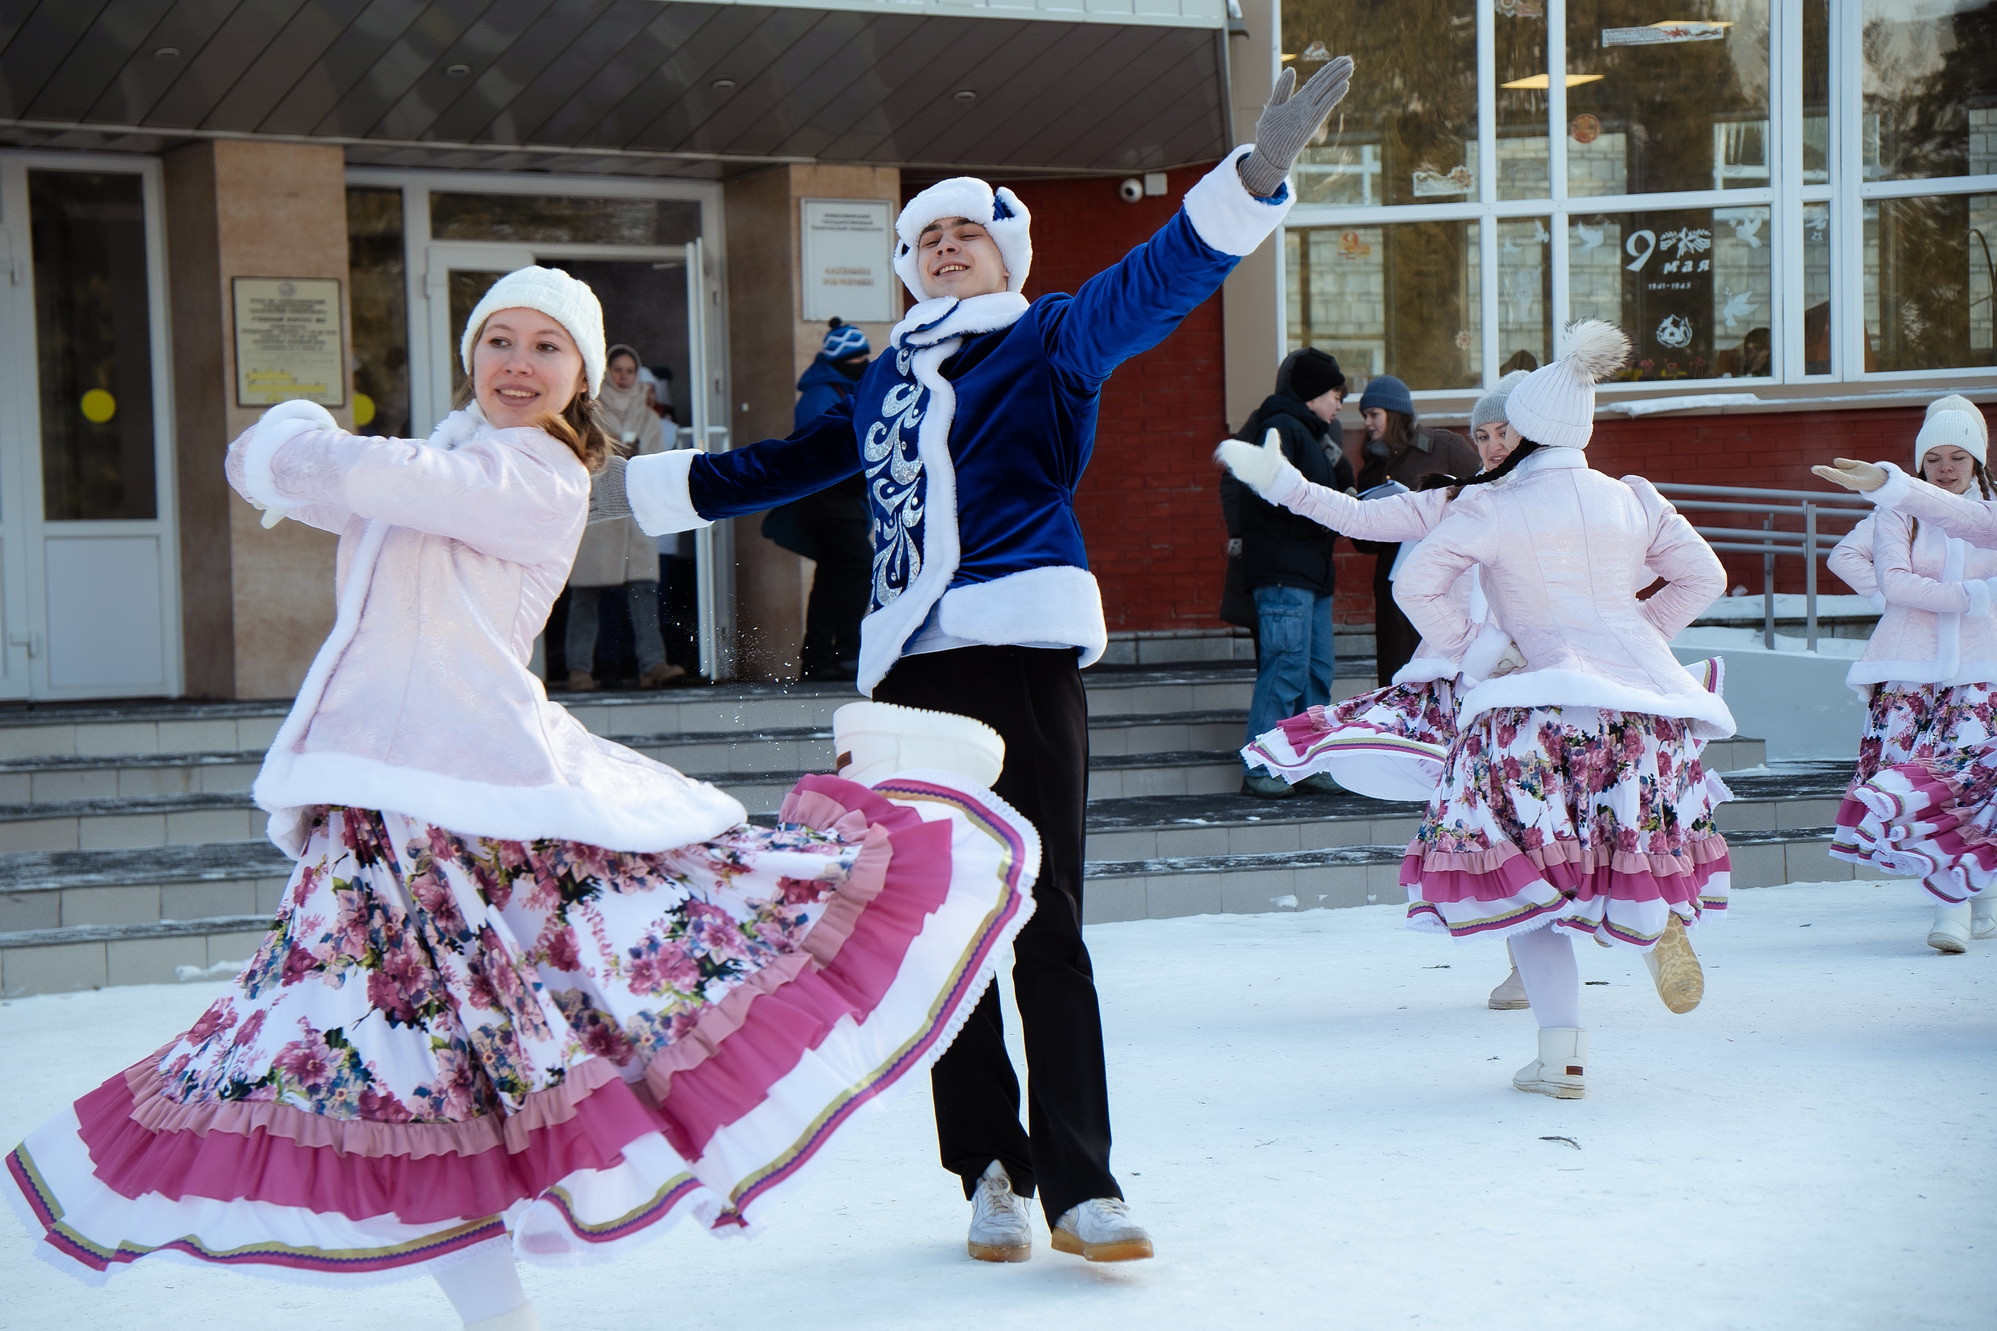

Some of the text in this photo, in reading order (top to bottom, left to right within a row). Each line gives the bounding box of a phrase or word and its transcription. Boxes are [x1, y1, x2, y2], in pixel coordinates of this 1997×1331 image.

[1626, 229, 1710, 275] 9 мая
[1648, 281, 1691, 290] 1941-1945
